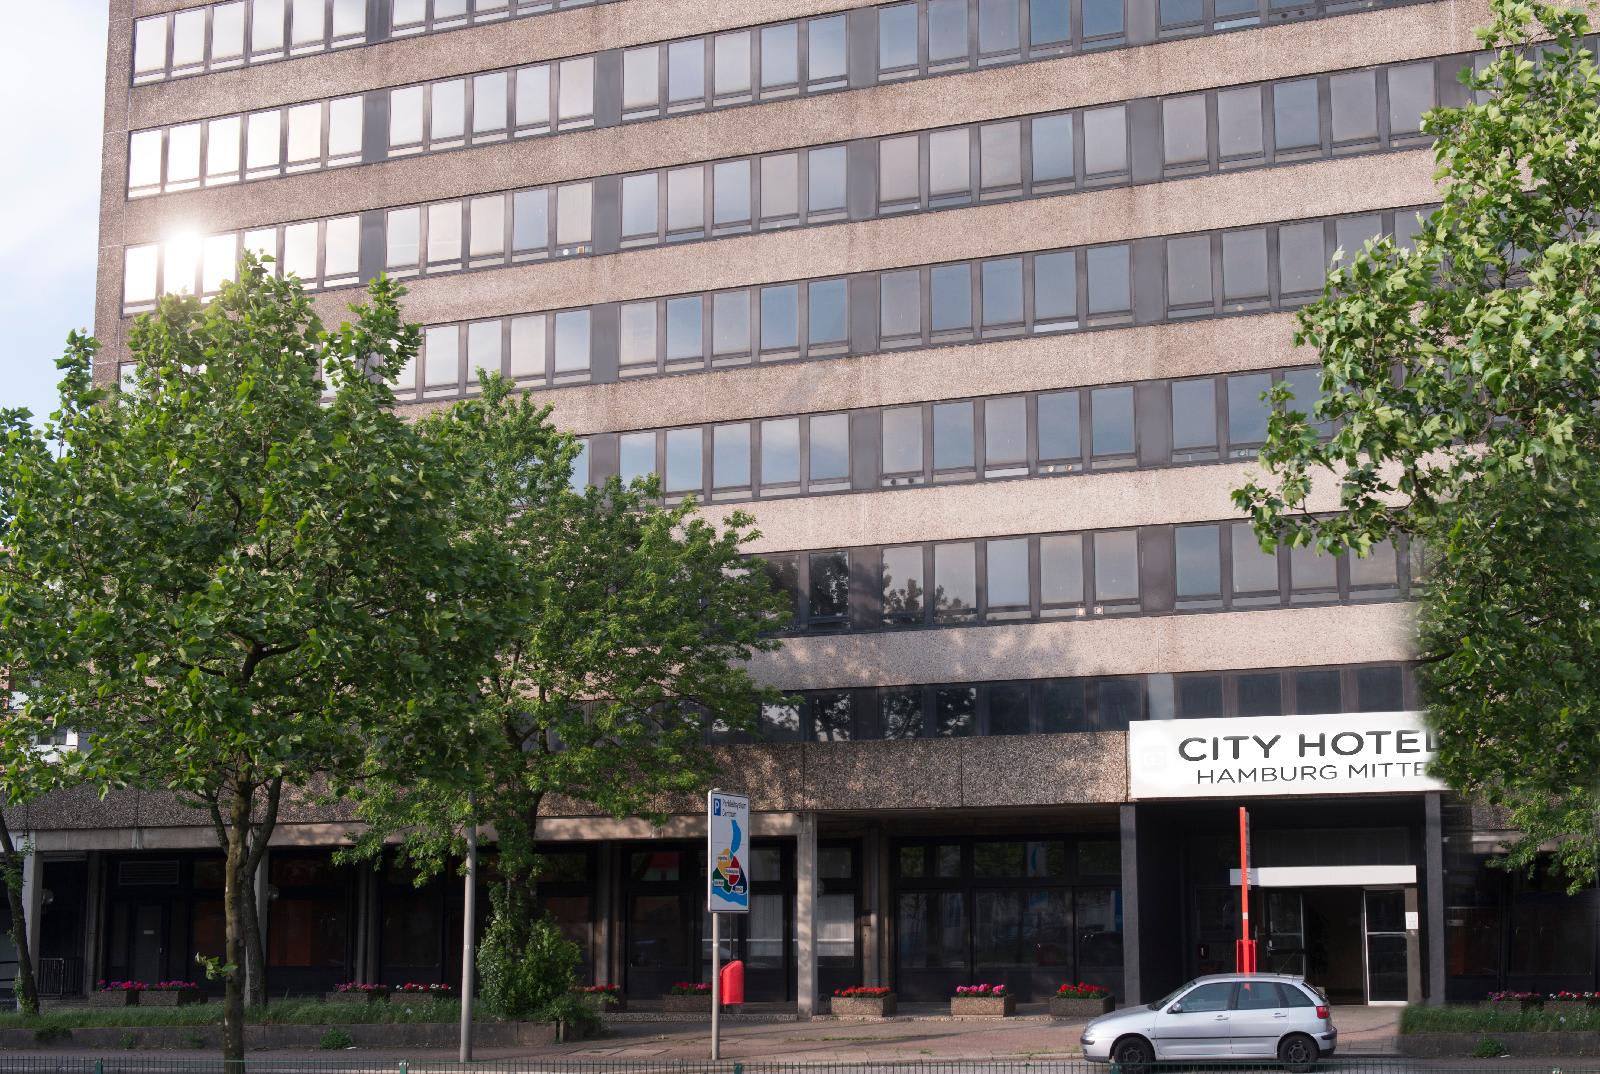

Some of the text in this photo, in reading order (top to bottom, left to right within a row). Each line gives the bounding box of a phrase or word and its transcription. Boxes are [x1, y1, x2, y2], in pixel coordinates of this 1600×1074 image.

[1178, 730, 1439, 762] CITY HOTEL
[1197, 762, 1428, 785] HAMBURG MITTE
